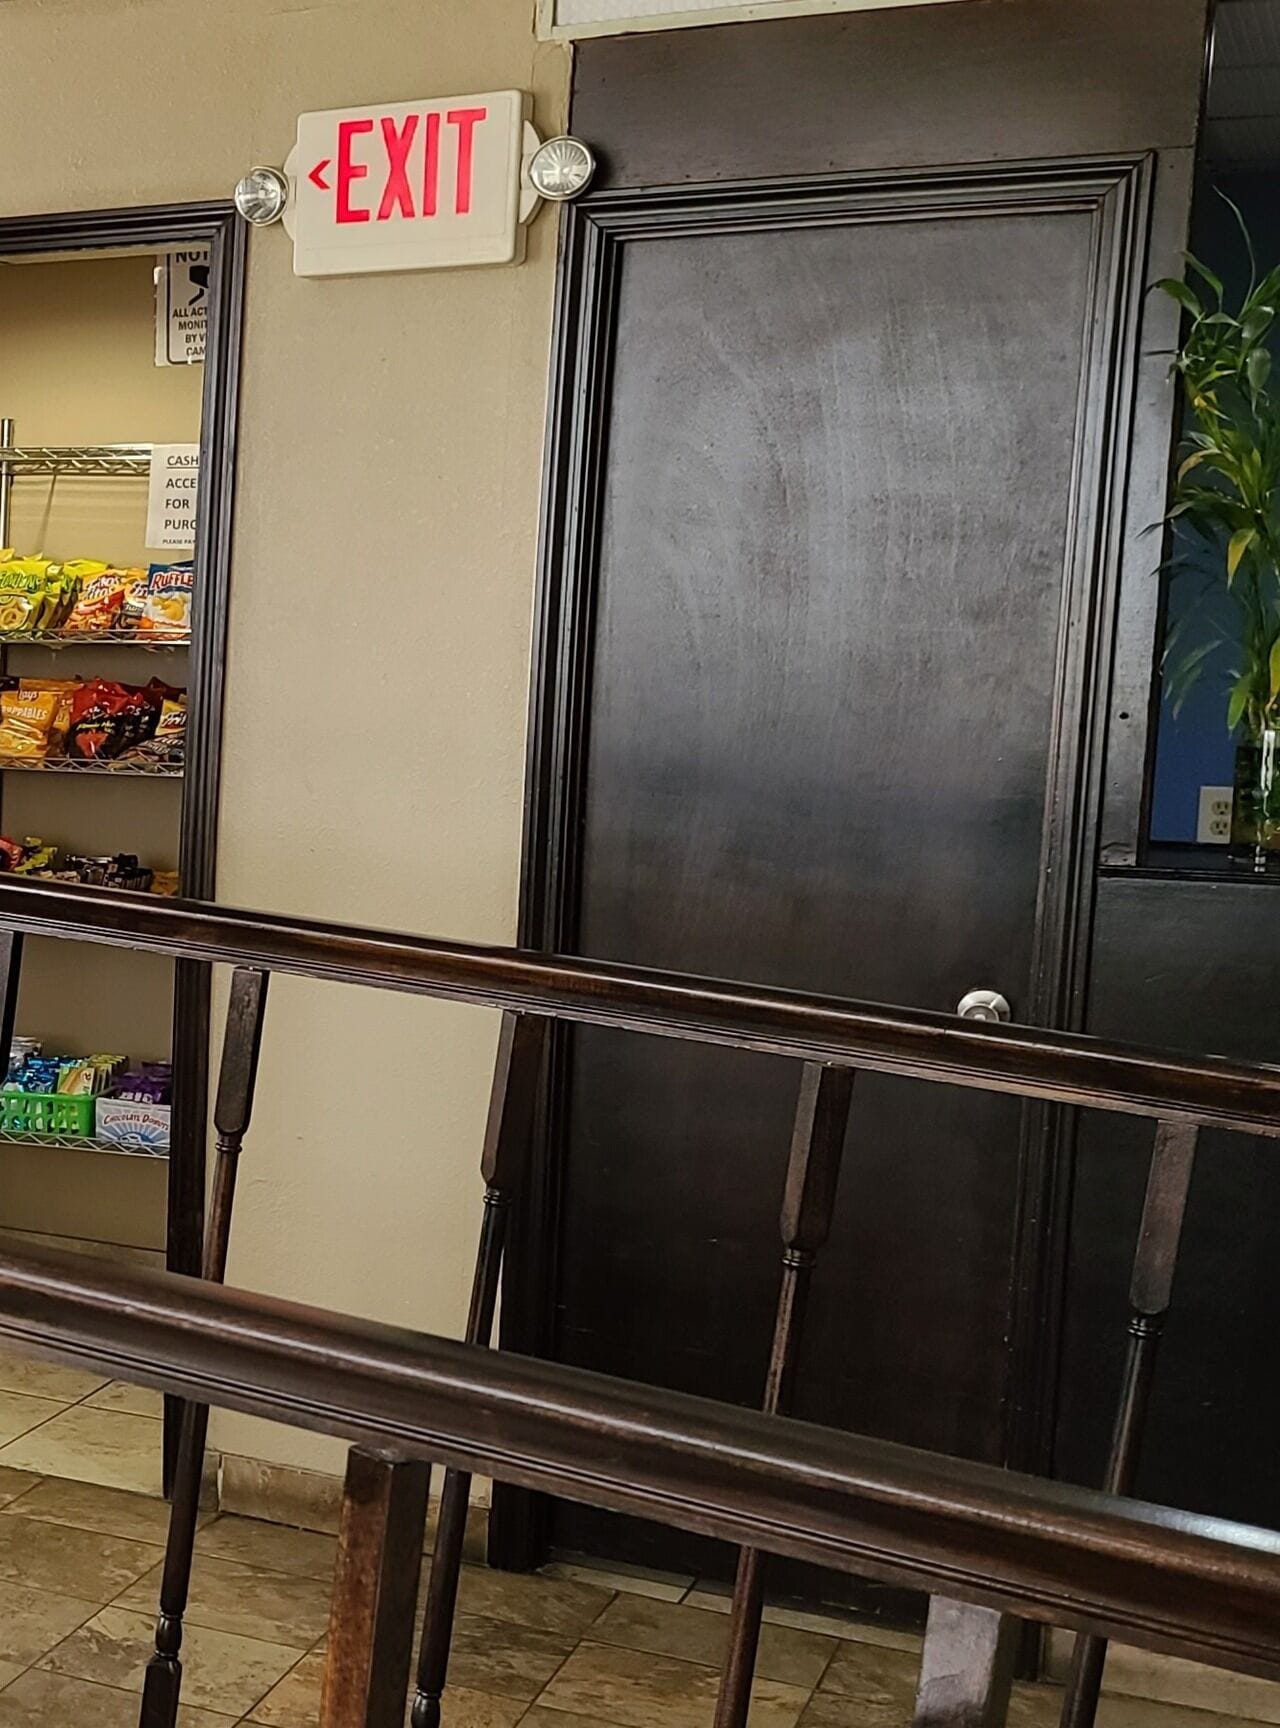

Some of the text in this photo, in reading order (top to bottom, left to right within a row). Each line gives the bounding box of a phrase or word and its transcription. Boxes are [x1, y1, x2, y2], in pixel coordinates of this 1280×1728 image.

[335, 107, 487, 224] EXIT
[173, 308, 188, 318] ALL
[185, 334, 197, 343] BY
[167, 455, 199, 466] CASH
[165, 478, 196, 489] ACCE
[165, 498, 189, 509] FOR
